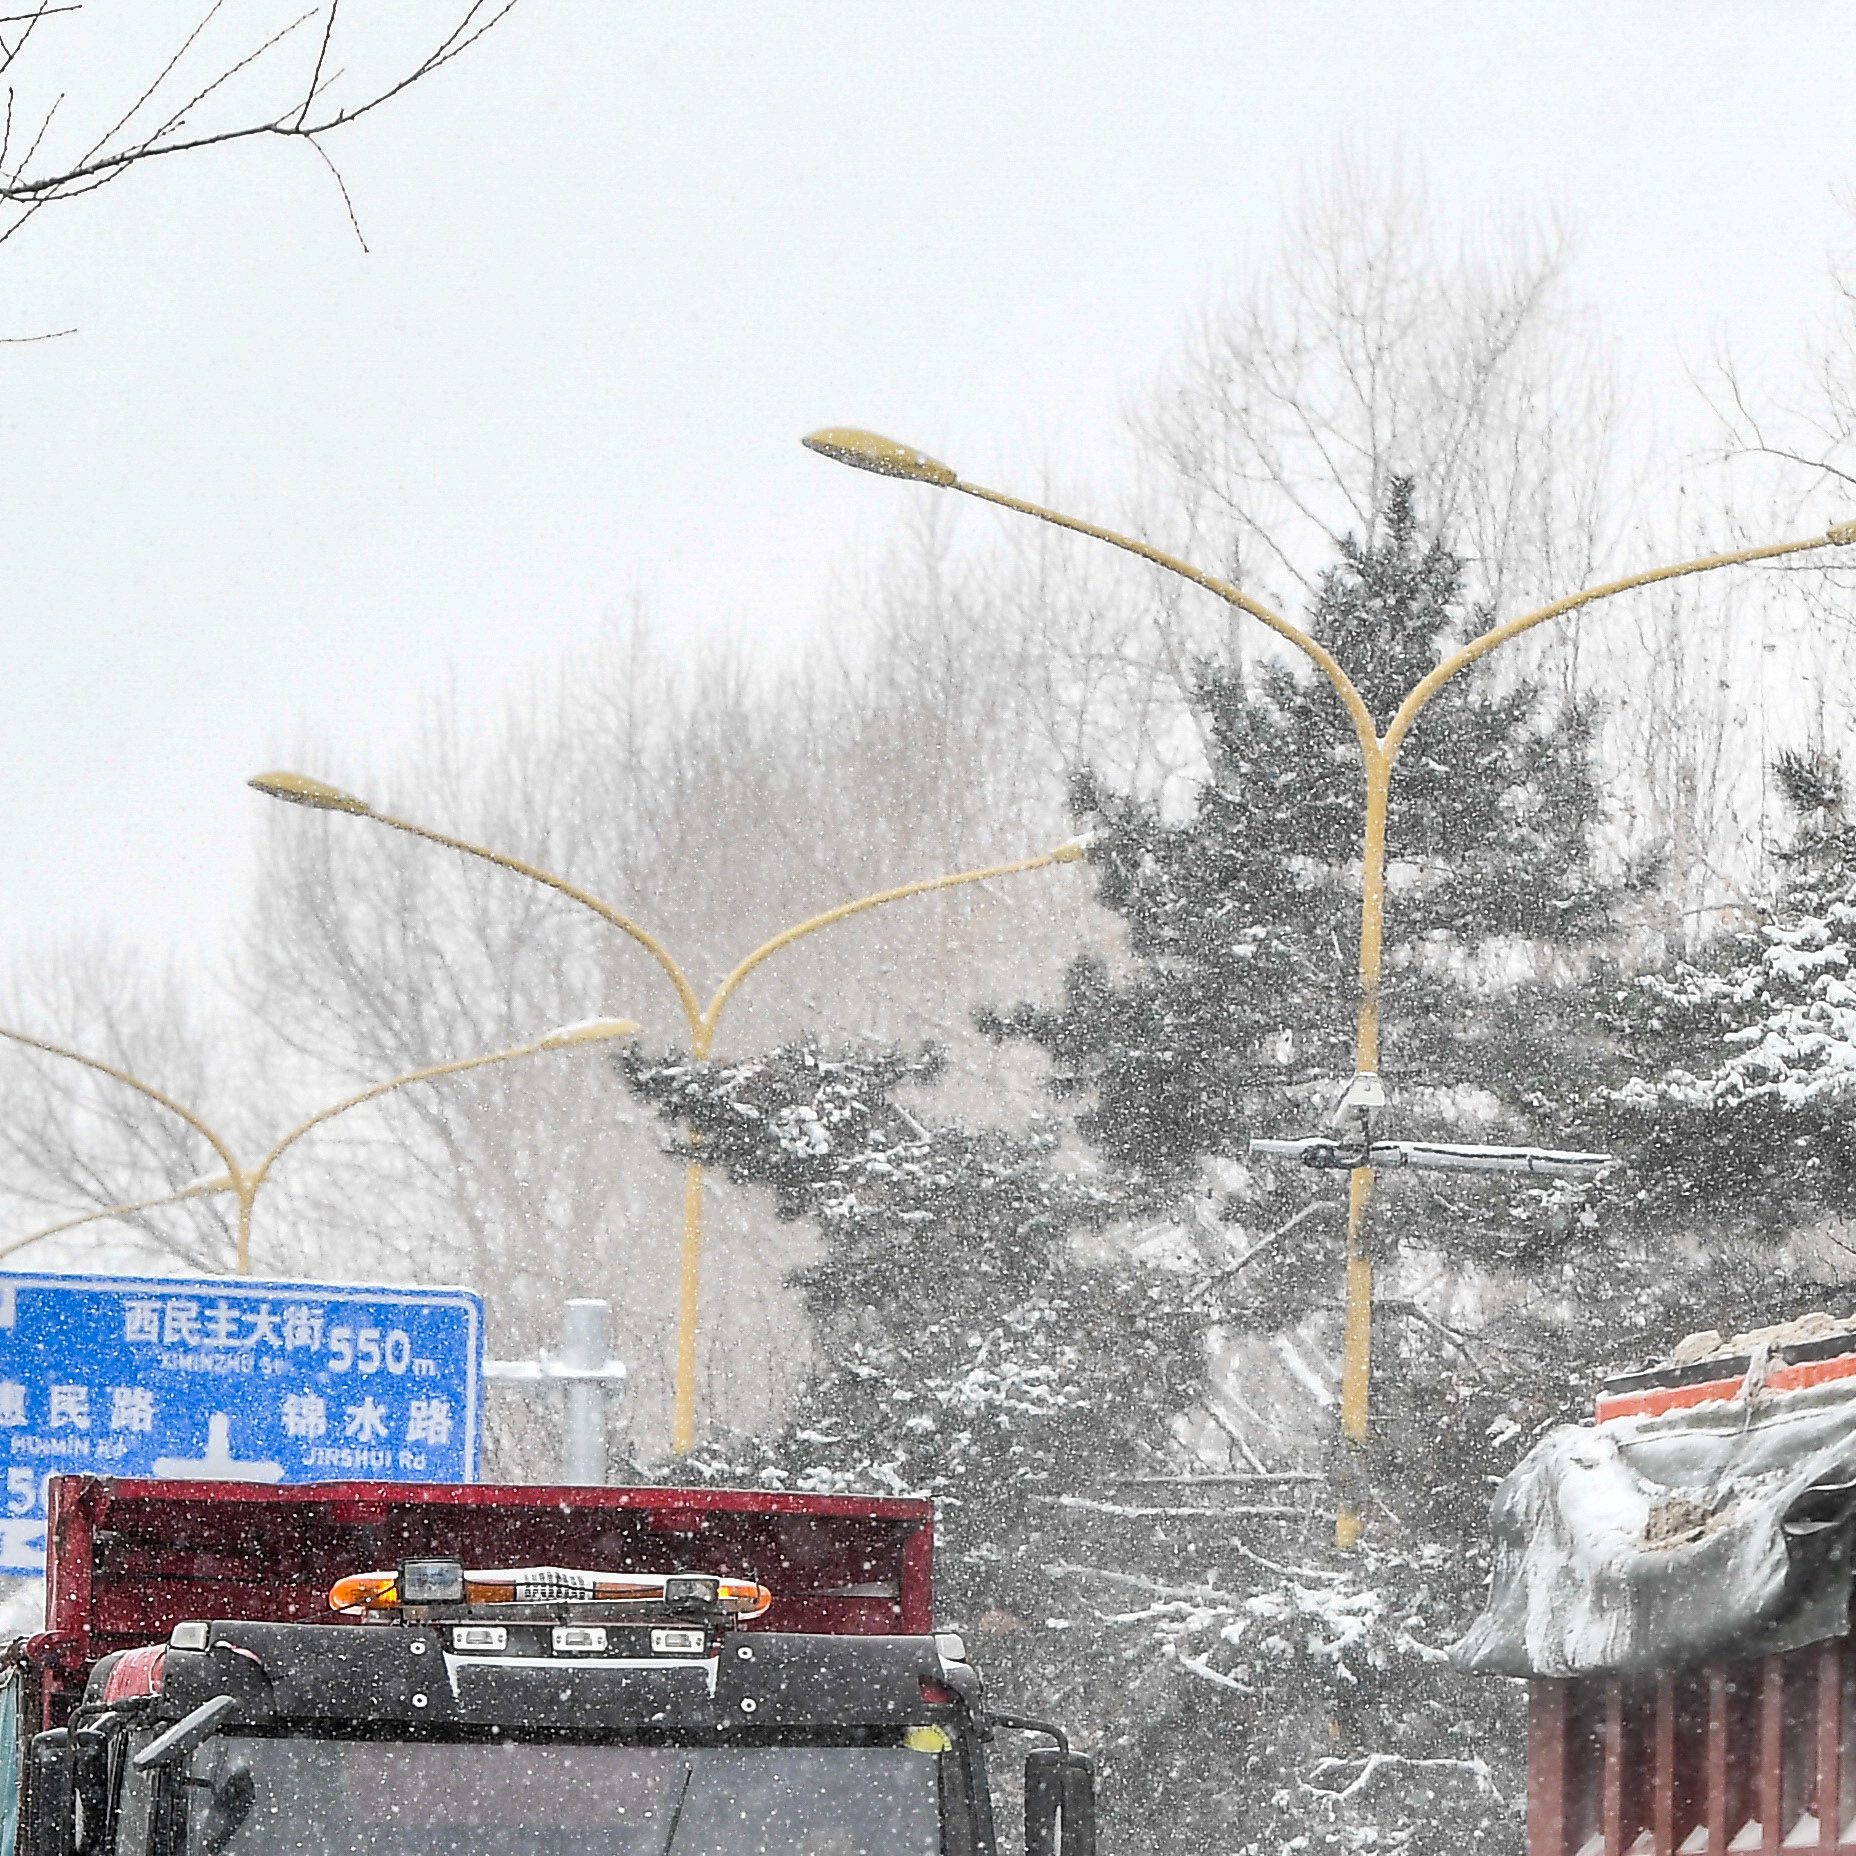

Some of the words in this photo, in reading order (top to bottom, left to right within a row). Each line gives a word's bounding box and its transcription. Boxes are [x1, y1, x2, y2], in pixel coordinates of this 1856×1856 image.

[125, 1299, 324, 1351] 西民主大街
[281, 1393, 453, 1446] 锦水路
[302, 1447, 393, 1469] JINSHUI
[398, 1449, 427, 1472] Rd
